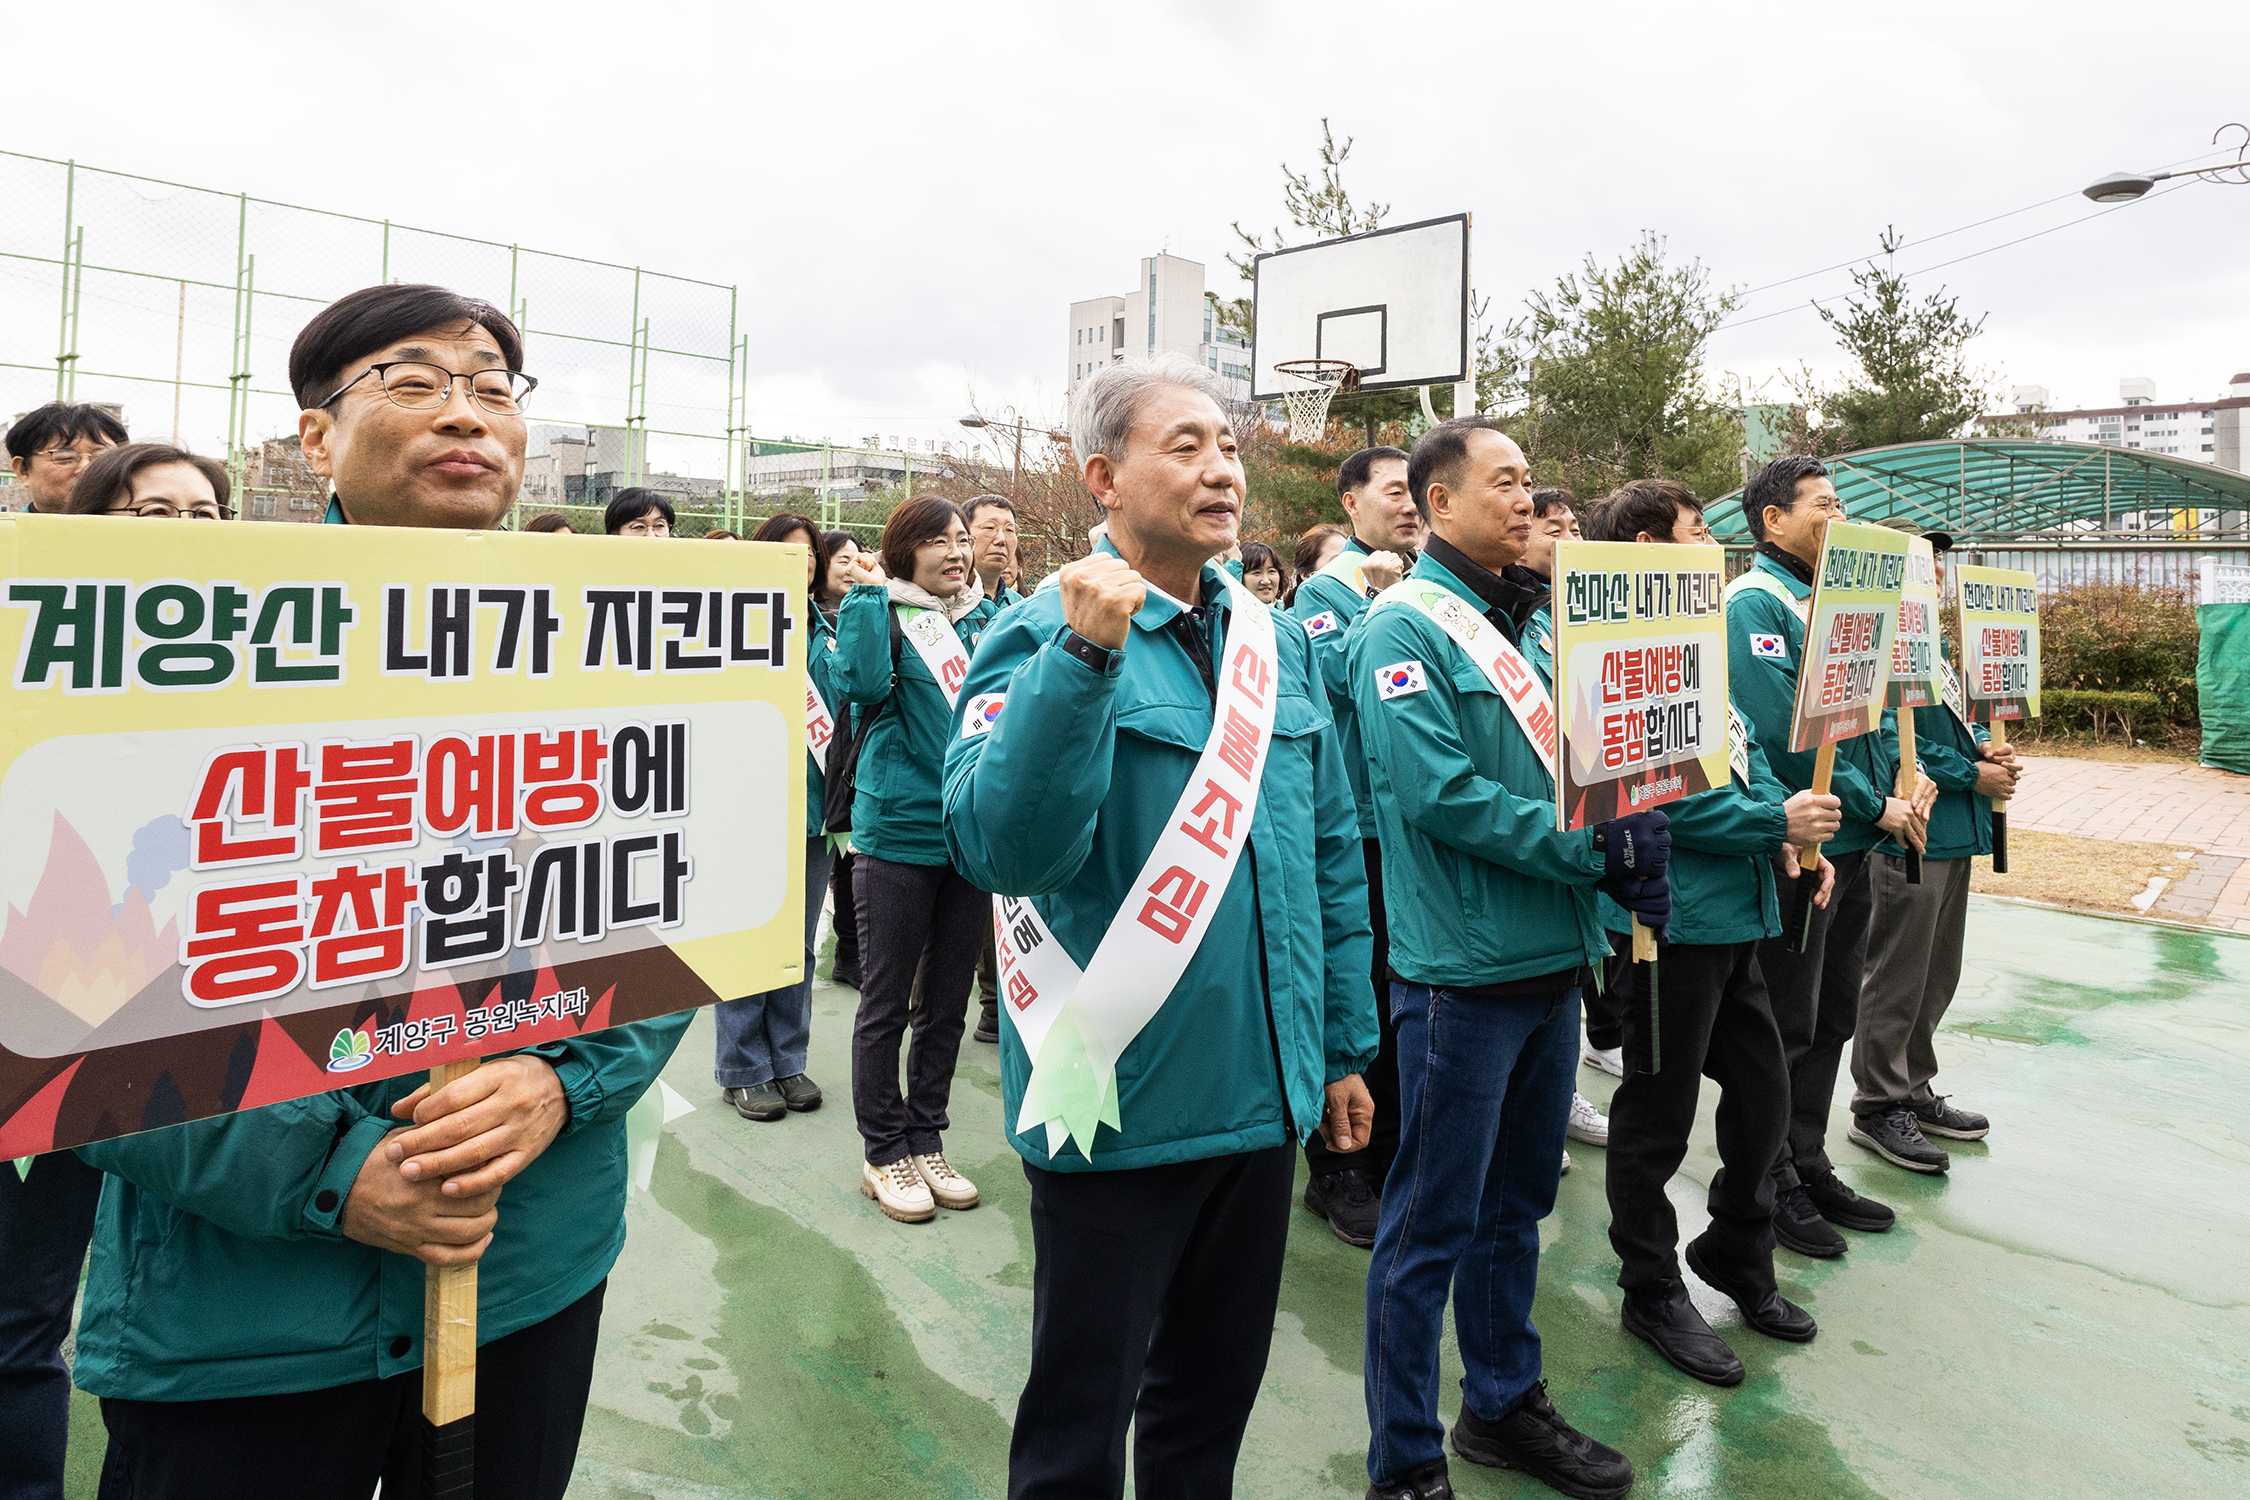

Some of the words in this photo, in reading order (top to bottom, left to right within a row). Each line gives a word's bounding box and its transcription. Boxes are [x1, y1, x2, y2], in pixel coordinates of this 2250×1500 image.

[1823, 544, 1857, 590] 천마산
[1855, 549, 1878, 591] 내가
[1876, 552, 1905, 592] 지킨다
[1565, 571, 1630, 623] 천마산
[1635, 573, 1671, 618] 내가
[1676, 573, 1722, 616] 지킨다
[1896, 600, 1930, 635] 불예방에
[1963, 580, 1994, 611] 천마산
[1996, 584, 2014, 613] 내가
[2016, 587, 2037, 614] 지킨다
[8, 582, 353, 690] 계양산
[386, 587, 559, 678] 내가
[583, 589, 795, 672] 지킨다
[1828, 611, 1885, 656] 산불예방에
[1892, 637, 1932, 674] 동참합시다
[1982, 627, 2028, 658] 산불예방에
[1601, 642, 1700, 703] 산불예방에
[1821, 658, 1877, 706] 동참합시다
[1982, 661, 2029, 692] 동참합시다
[1602, 700, 1702, 768] 동참합시다
[190, 723, 689, 865] 산불예방에
[1136, 643, 1272, 945] 산불조심
[185, 832, 693, 1003] 동참합시다
[374, 1016, 458, 1055] 계양구
[463, 986, 589, 1038] 공원녹지과
